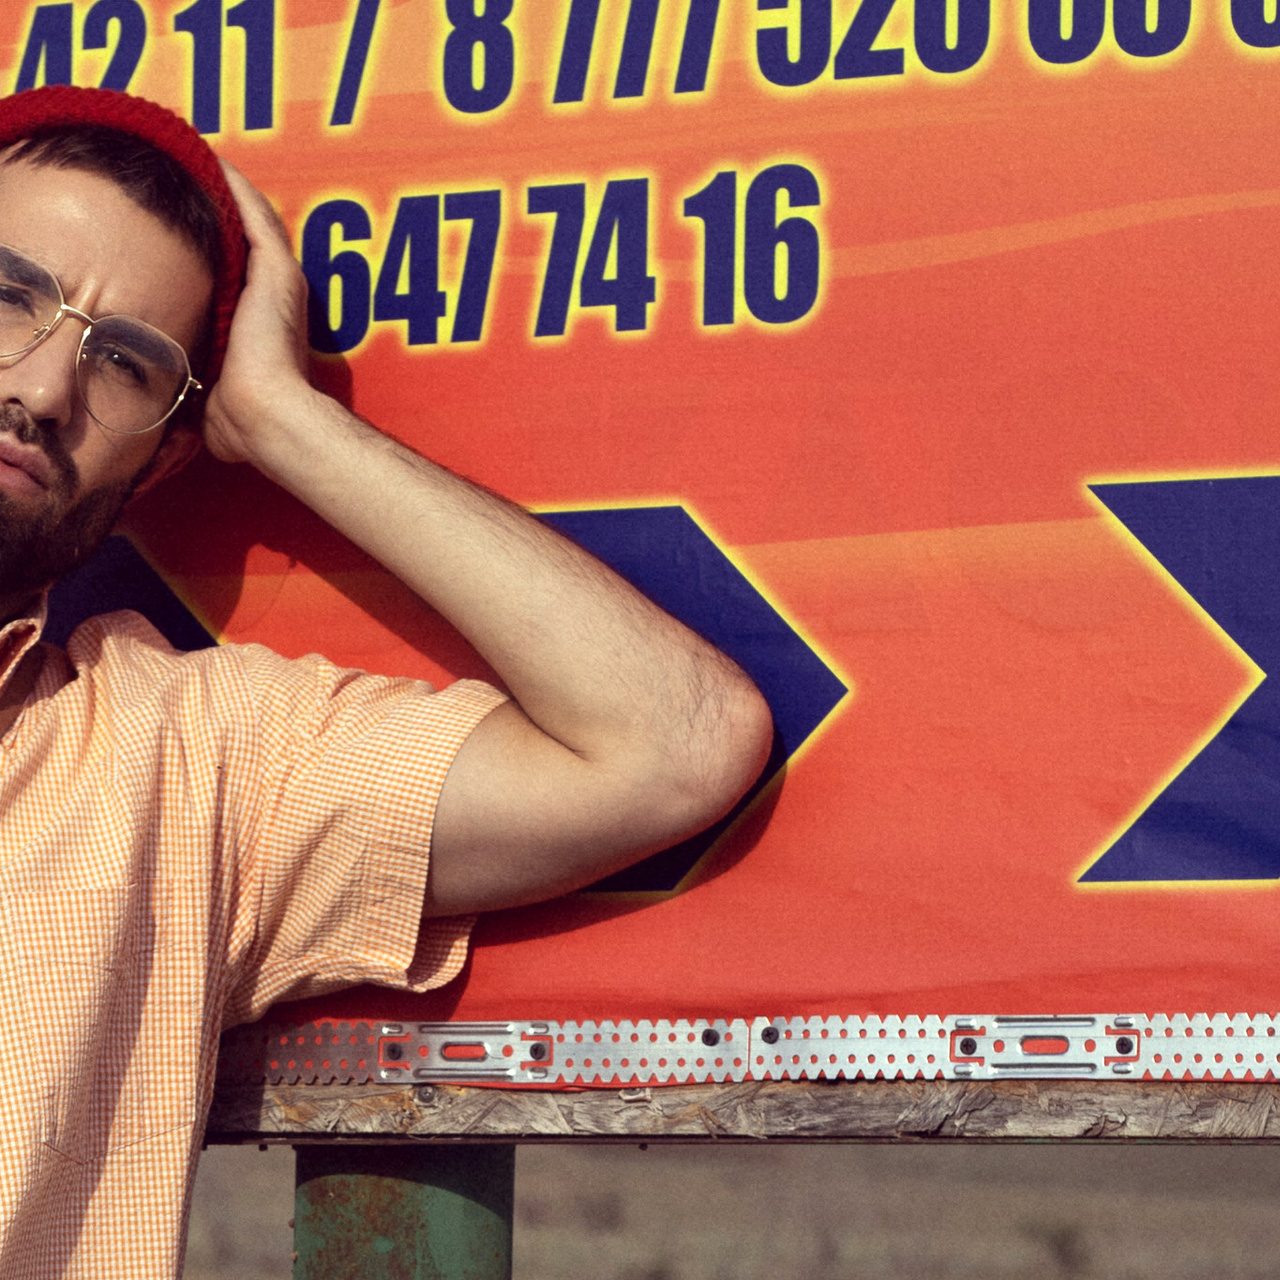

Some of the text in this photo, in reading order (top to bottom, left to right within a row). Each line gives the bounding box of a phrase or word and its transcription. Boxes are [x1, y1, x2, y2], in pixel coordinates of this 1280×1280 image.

[14, 0, 148, 92] 42
[173, 0, 275, 135] 11
[443, 0, 515, 114] 8
[301, 163, 821, 354] 647 74 16
